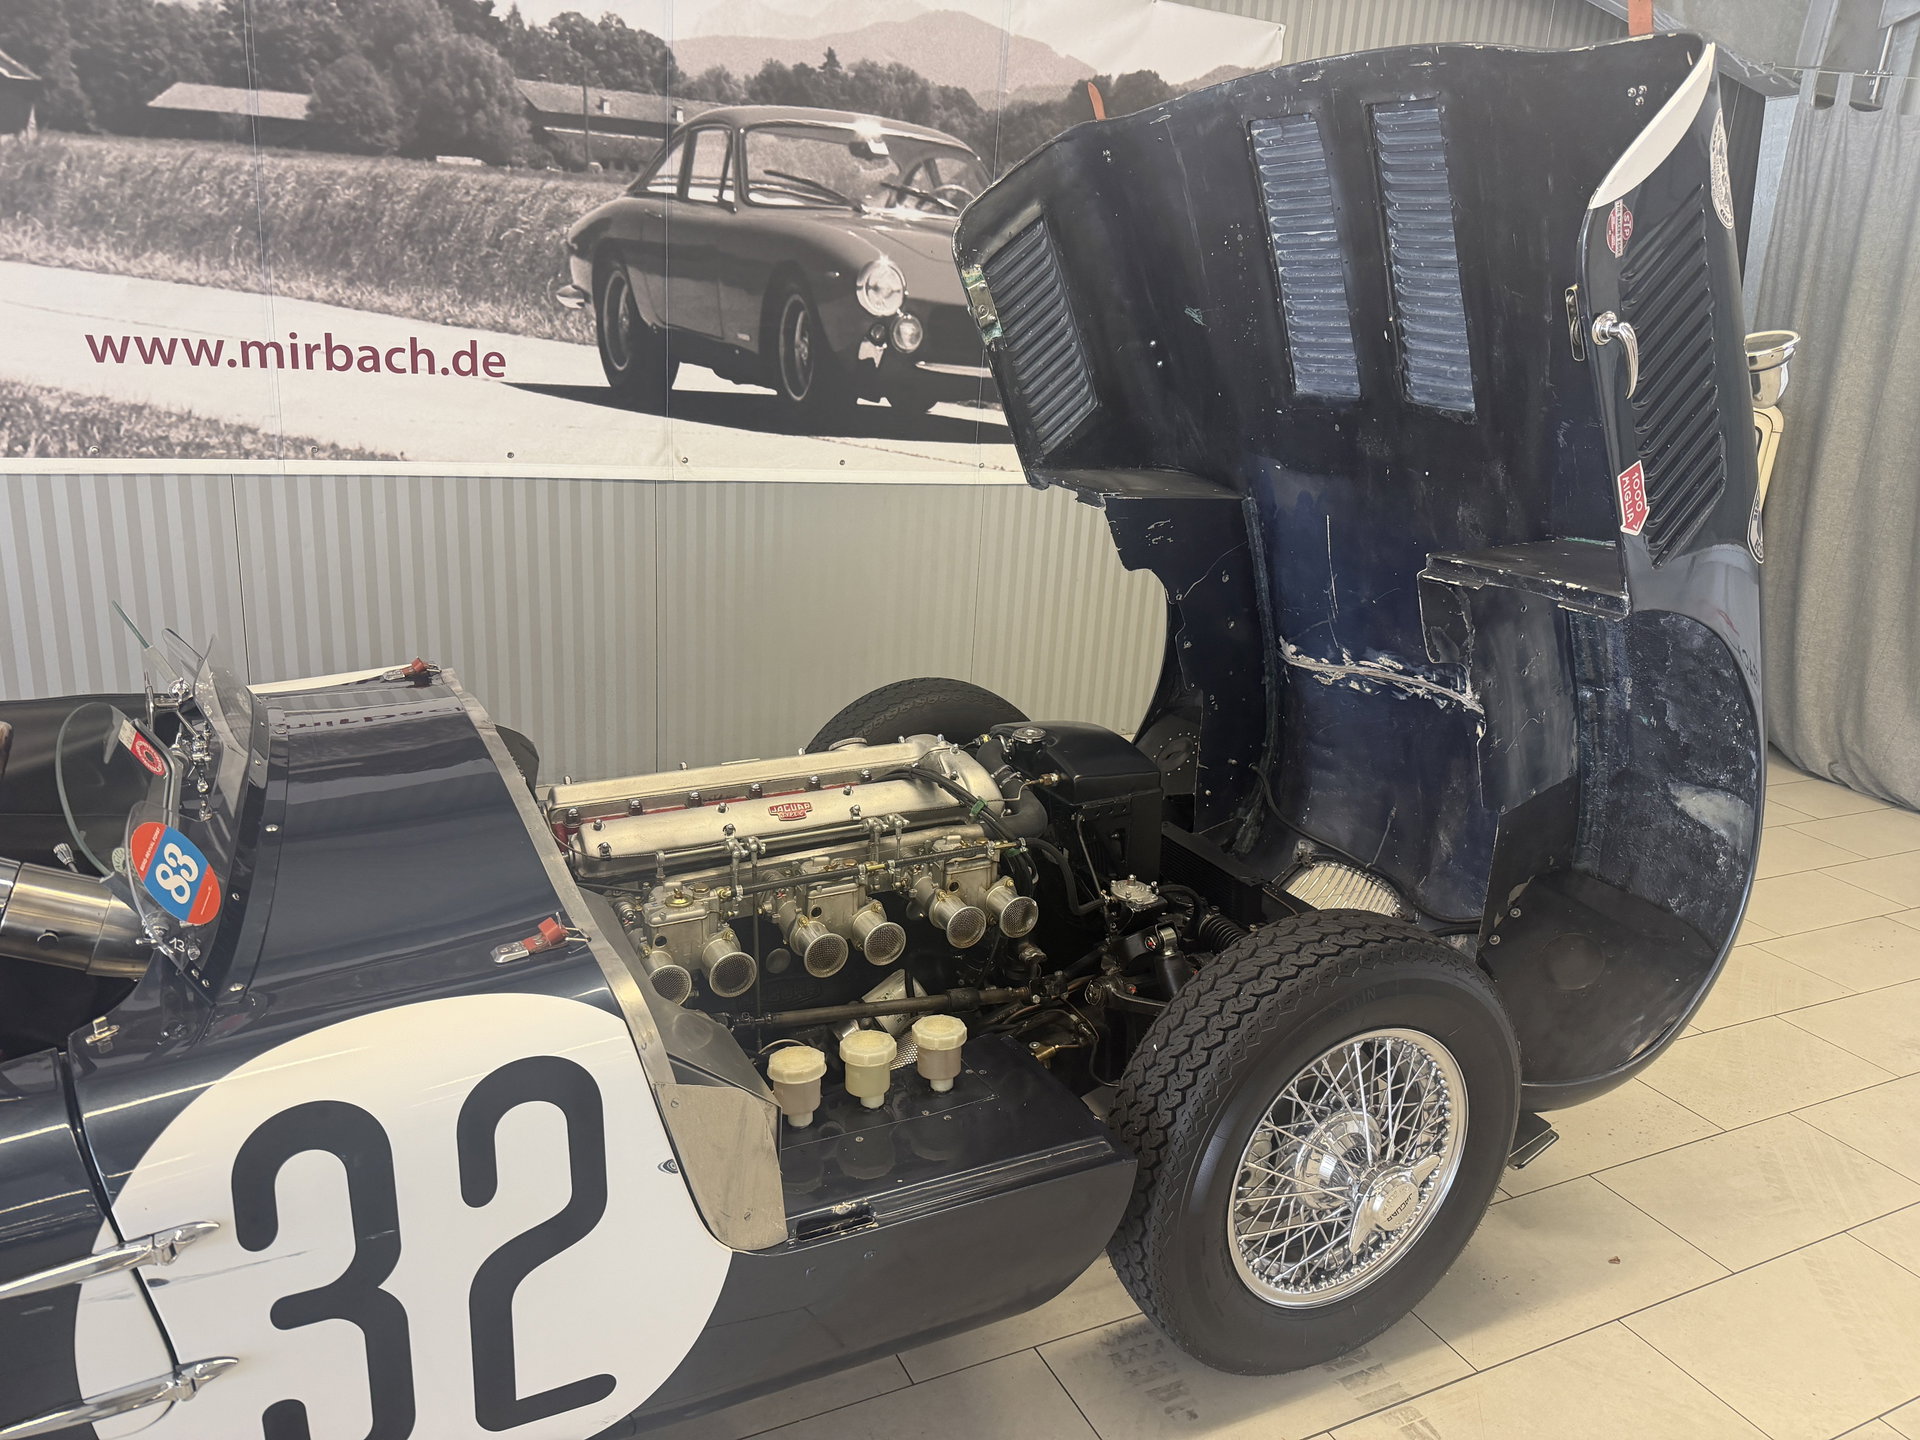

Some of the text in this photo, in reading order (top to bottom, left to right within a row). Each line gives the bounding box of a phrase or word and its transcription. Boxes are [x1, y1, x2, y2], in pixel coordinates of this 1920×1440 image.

[1623, 214, 1632, 238] STP
[85, 332, 507, 378] www.mirbach.de
[1622, 476, 1635, 523] MIGLIA
[1631, 472, 1643, 512] 1000
[771, 803, 811, 814] JAGUAR
[155, 842, 199, 904] 83
[1386, 1193, 1413, 1222] JAGUAR
[231, 1055, 617, 1440] 32
